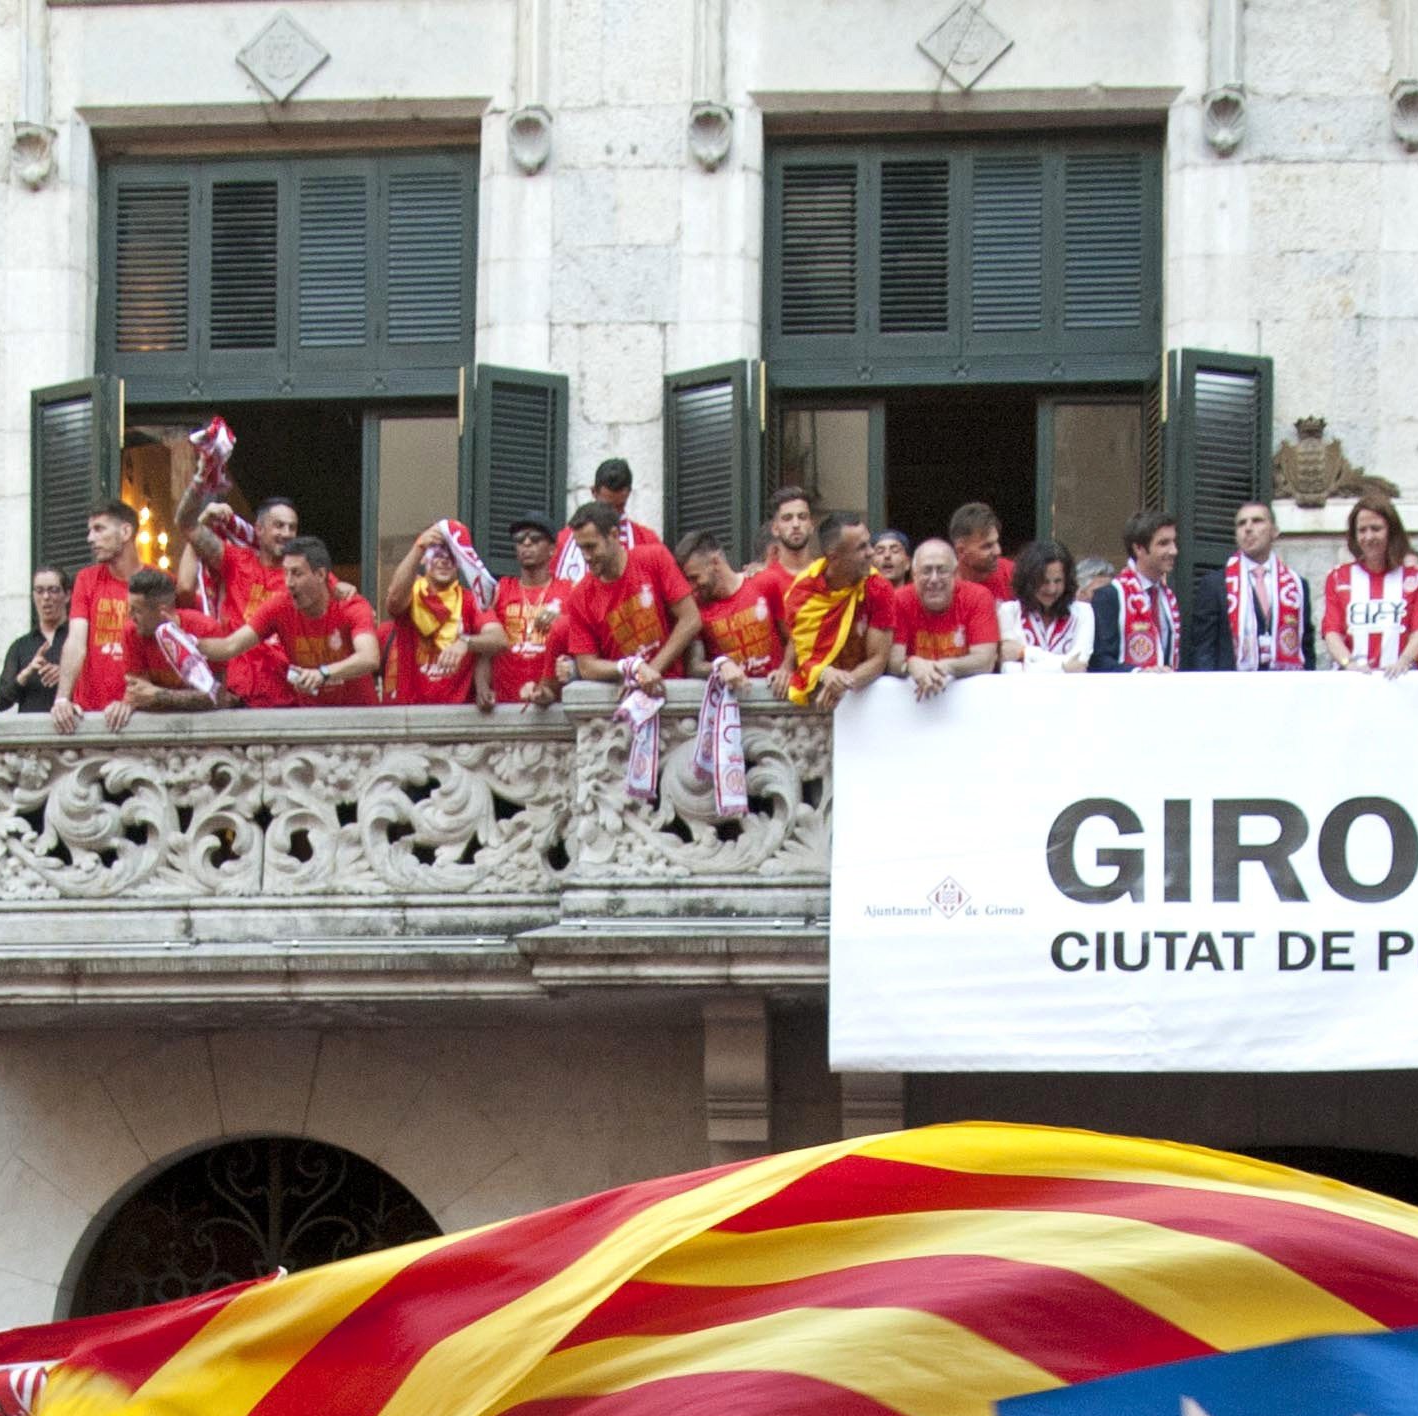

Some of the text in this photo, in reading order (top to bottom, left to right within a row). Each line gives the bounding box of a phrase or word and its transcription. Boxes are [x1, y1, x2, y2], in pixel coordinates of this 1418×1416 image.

[864, 904, 1025, 918] Ajuntament de Girona
[1050, 931, 1255, 973] CIUTAT
[1278, 931, 1356, 973] DE
